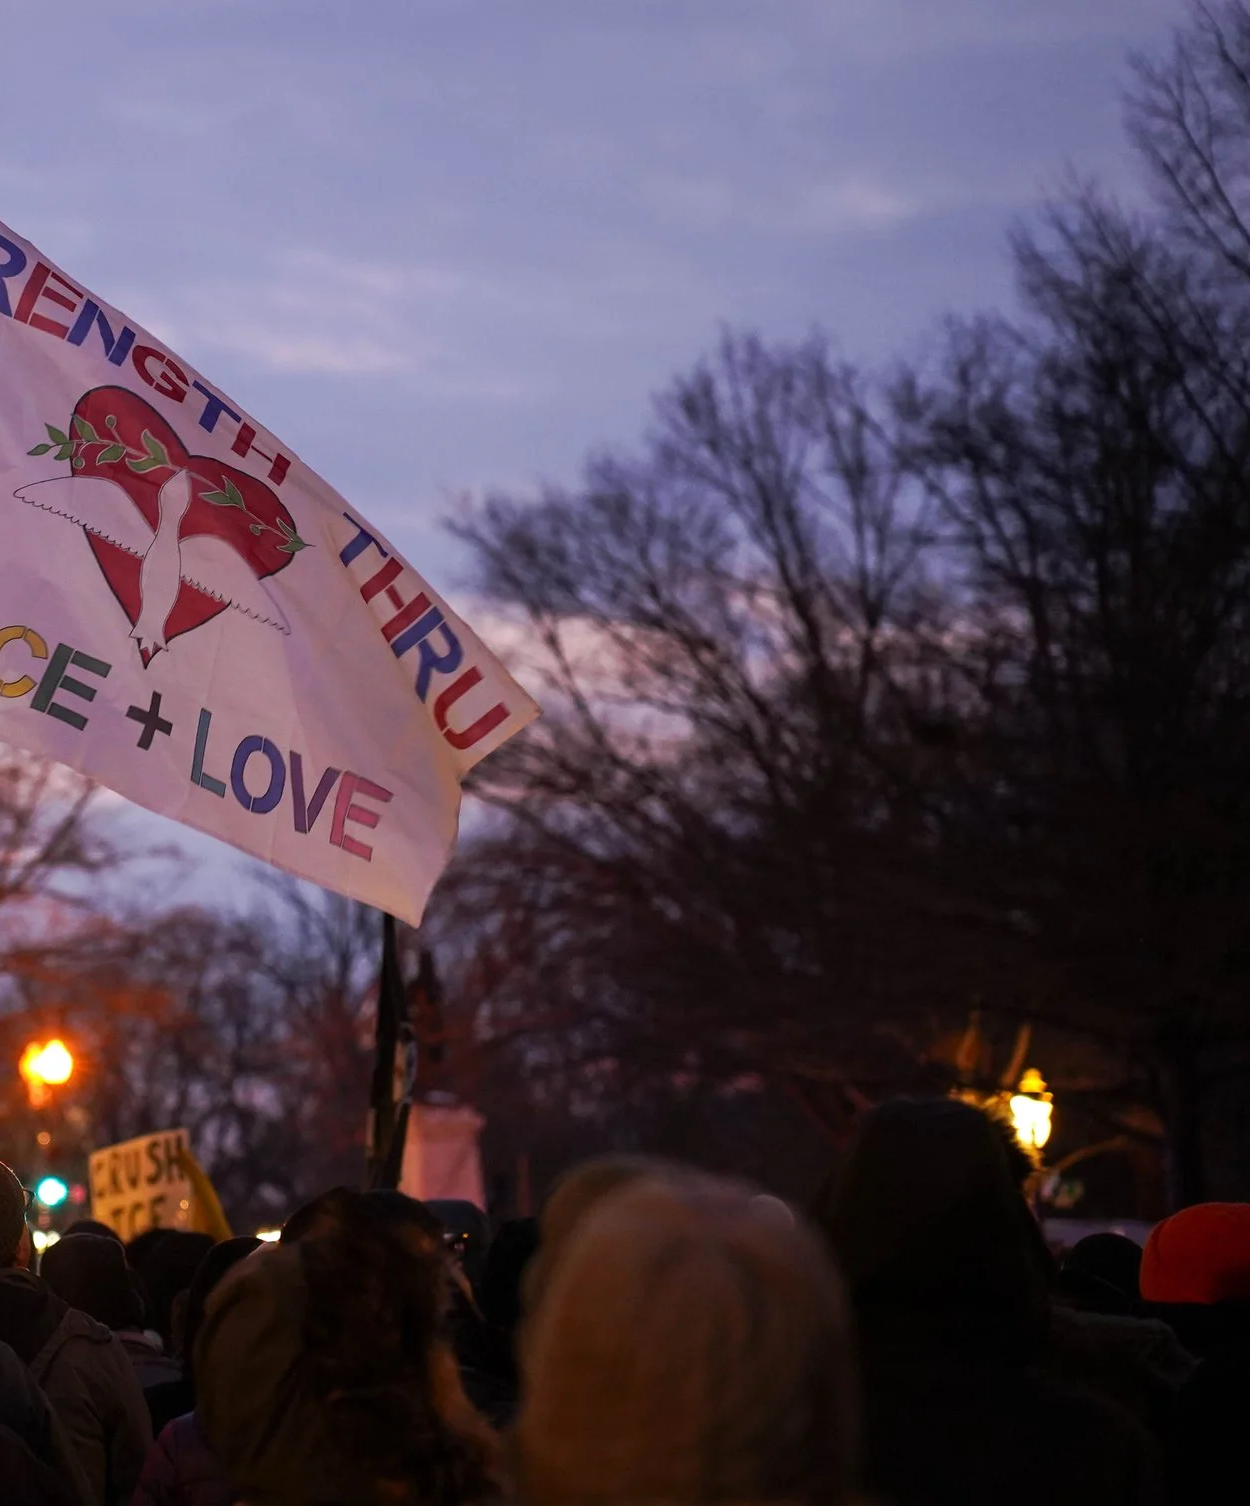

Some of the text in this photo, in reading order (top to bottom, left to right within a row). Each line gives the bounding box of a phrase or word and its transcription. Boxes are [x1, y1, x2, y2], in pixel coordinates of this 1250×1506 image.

[339, 510, 510, 751] THRU
[190, 707, 393, 862] LOVE
[95, 1136, 186, 1198] CRUSH
